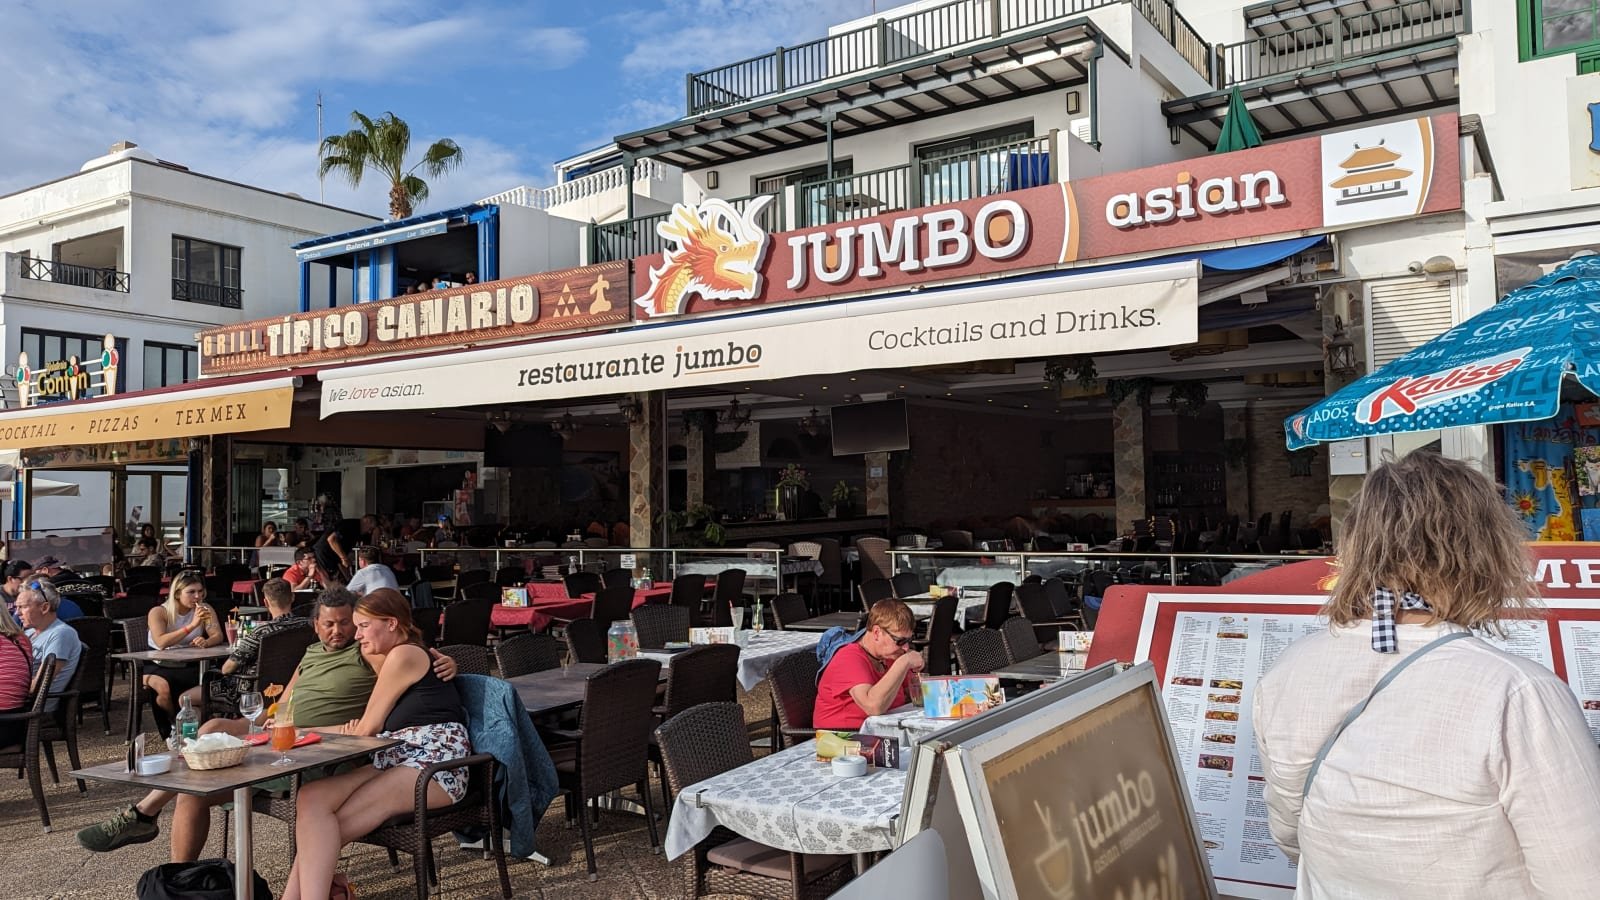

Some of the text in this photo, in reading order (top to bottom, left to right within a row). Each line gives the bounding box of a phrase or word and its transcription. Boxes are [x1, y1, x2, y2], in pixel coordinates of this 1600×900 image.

[1105, 169, 1286, 229] asian
[373, 237, 387, 246] Bar
[786, 199, 1030, 290] JUMBO
[204, 329, 265, 357] GRILL
[267, 283, 540, 357] TÍPICO CANARIO
[868, 304, 1162, 352] Cocktails and Drinks.
[211, 351, 267, 367] RESTAURANTE
[518, 343, 762, 387] restaurante jumbo
[329, 382, 425, 403] We love asian.
[1368, 356, 1522, 424] Kalise
[89, 416, 139, 433] PIZZAS
[1071, 769, 1157, 883] jumbo
